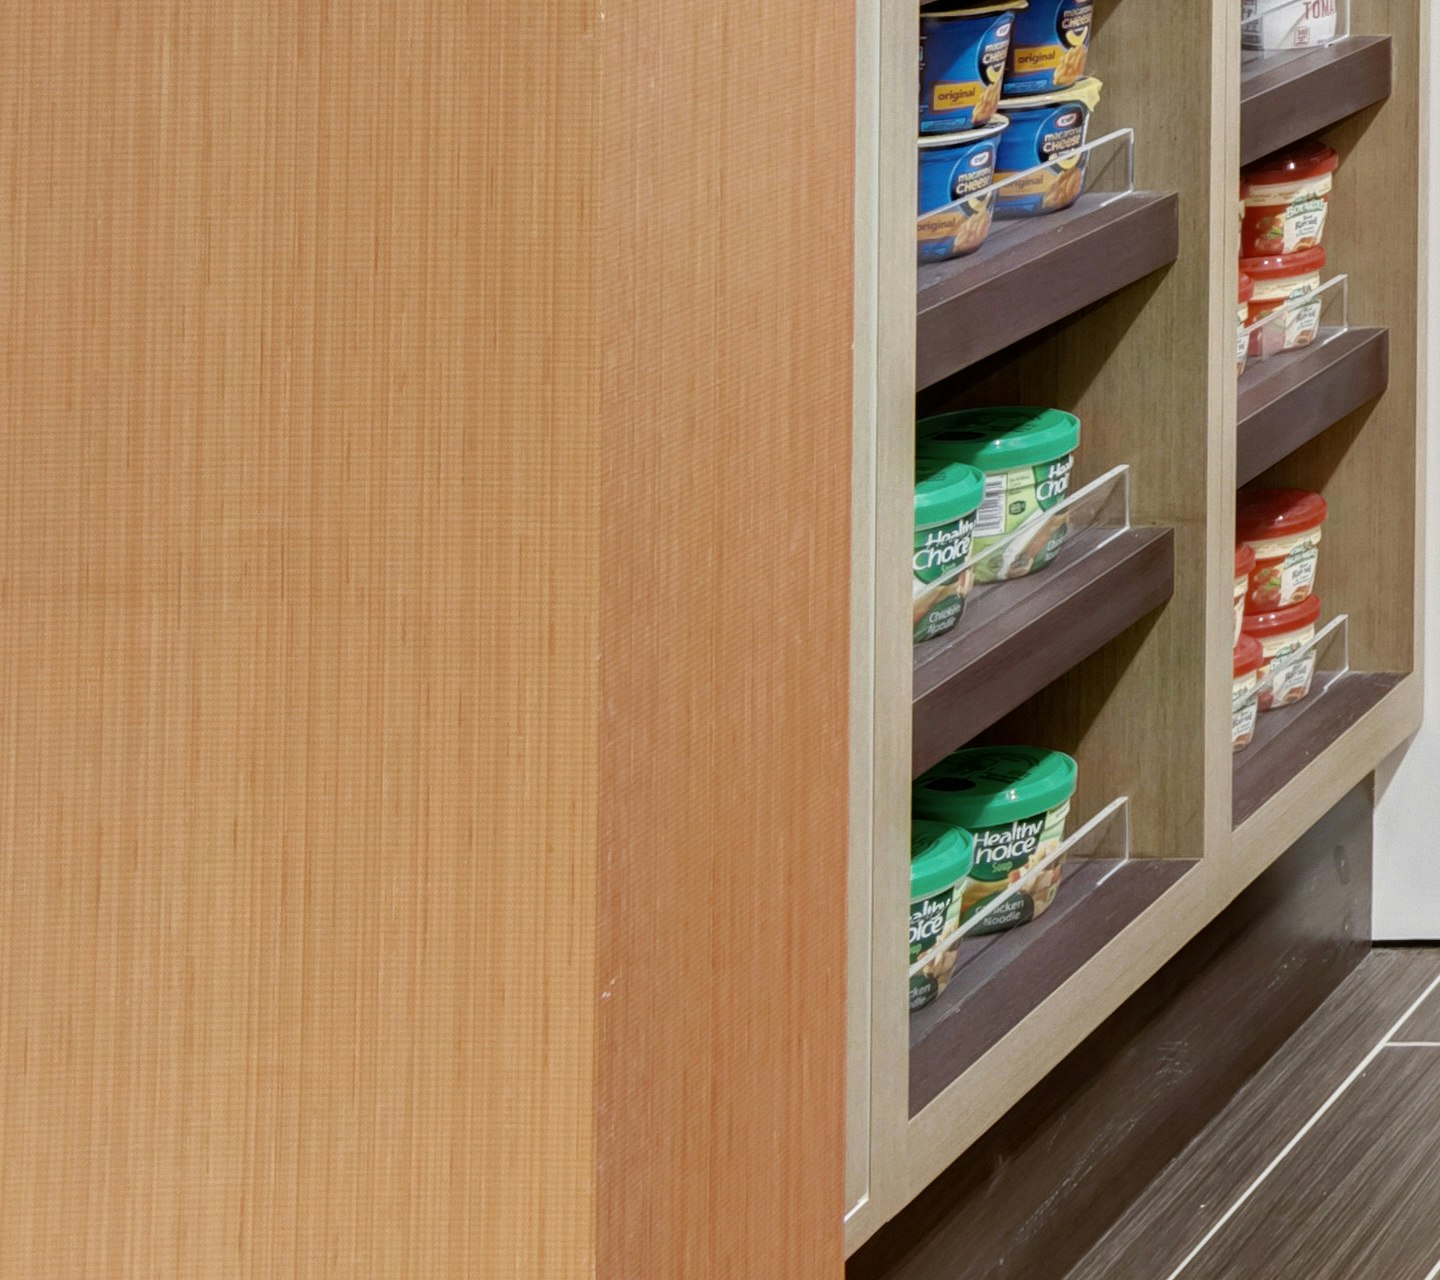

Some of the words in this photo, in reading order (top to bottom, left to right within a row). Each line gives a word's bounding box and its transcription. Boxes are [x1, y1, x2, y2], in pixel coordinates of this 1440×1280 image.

[1017, 51, 1056, 66] original
[937, 85, 976, 102] original
[912, 537, 971, 571] Choice
[929, 603, 962, 623] Chicken
[926, 616, 957, 636] Noodle
[974, 819, 1044, 848] Healthy
[974, 836, 1037, 865] hoice
[983, 911, 1022, 927] Noodle
